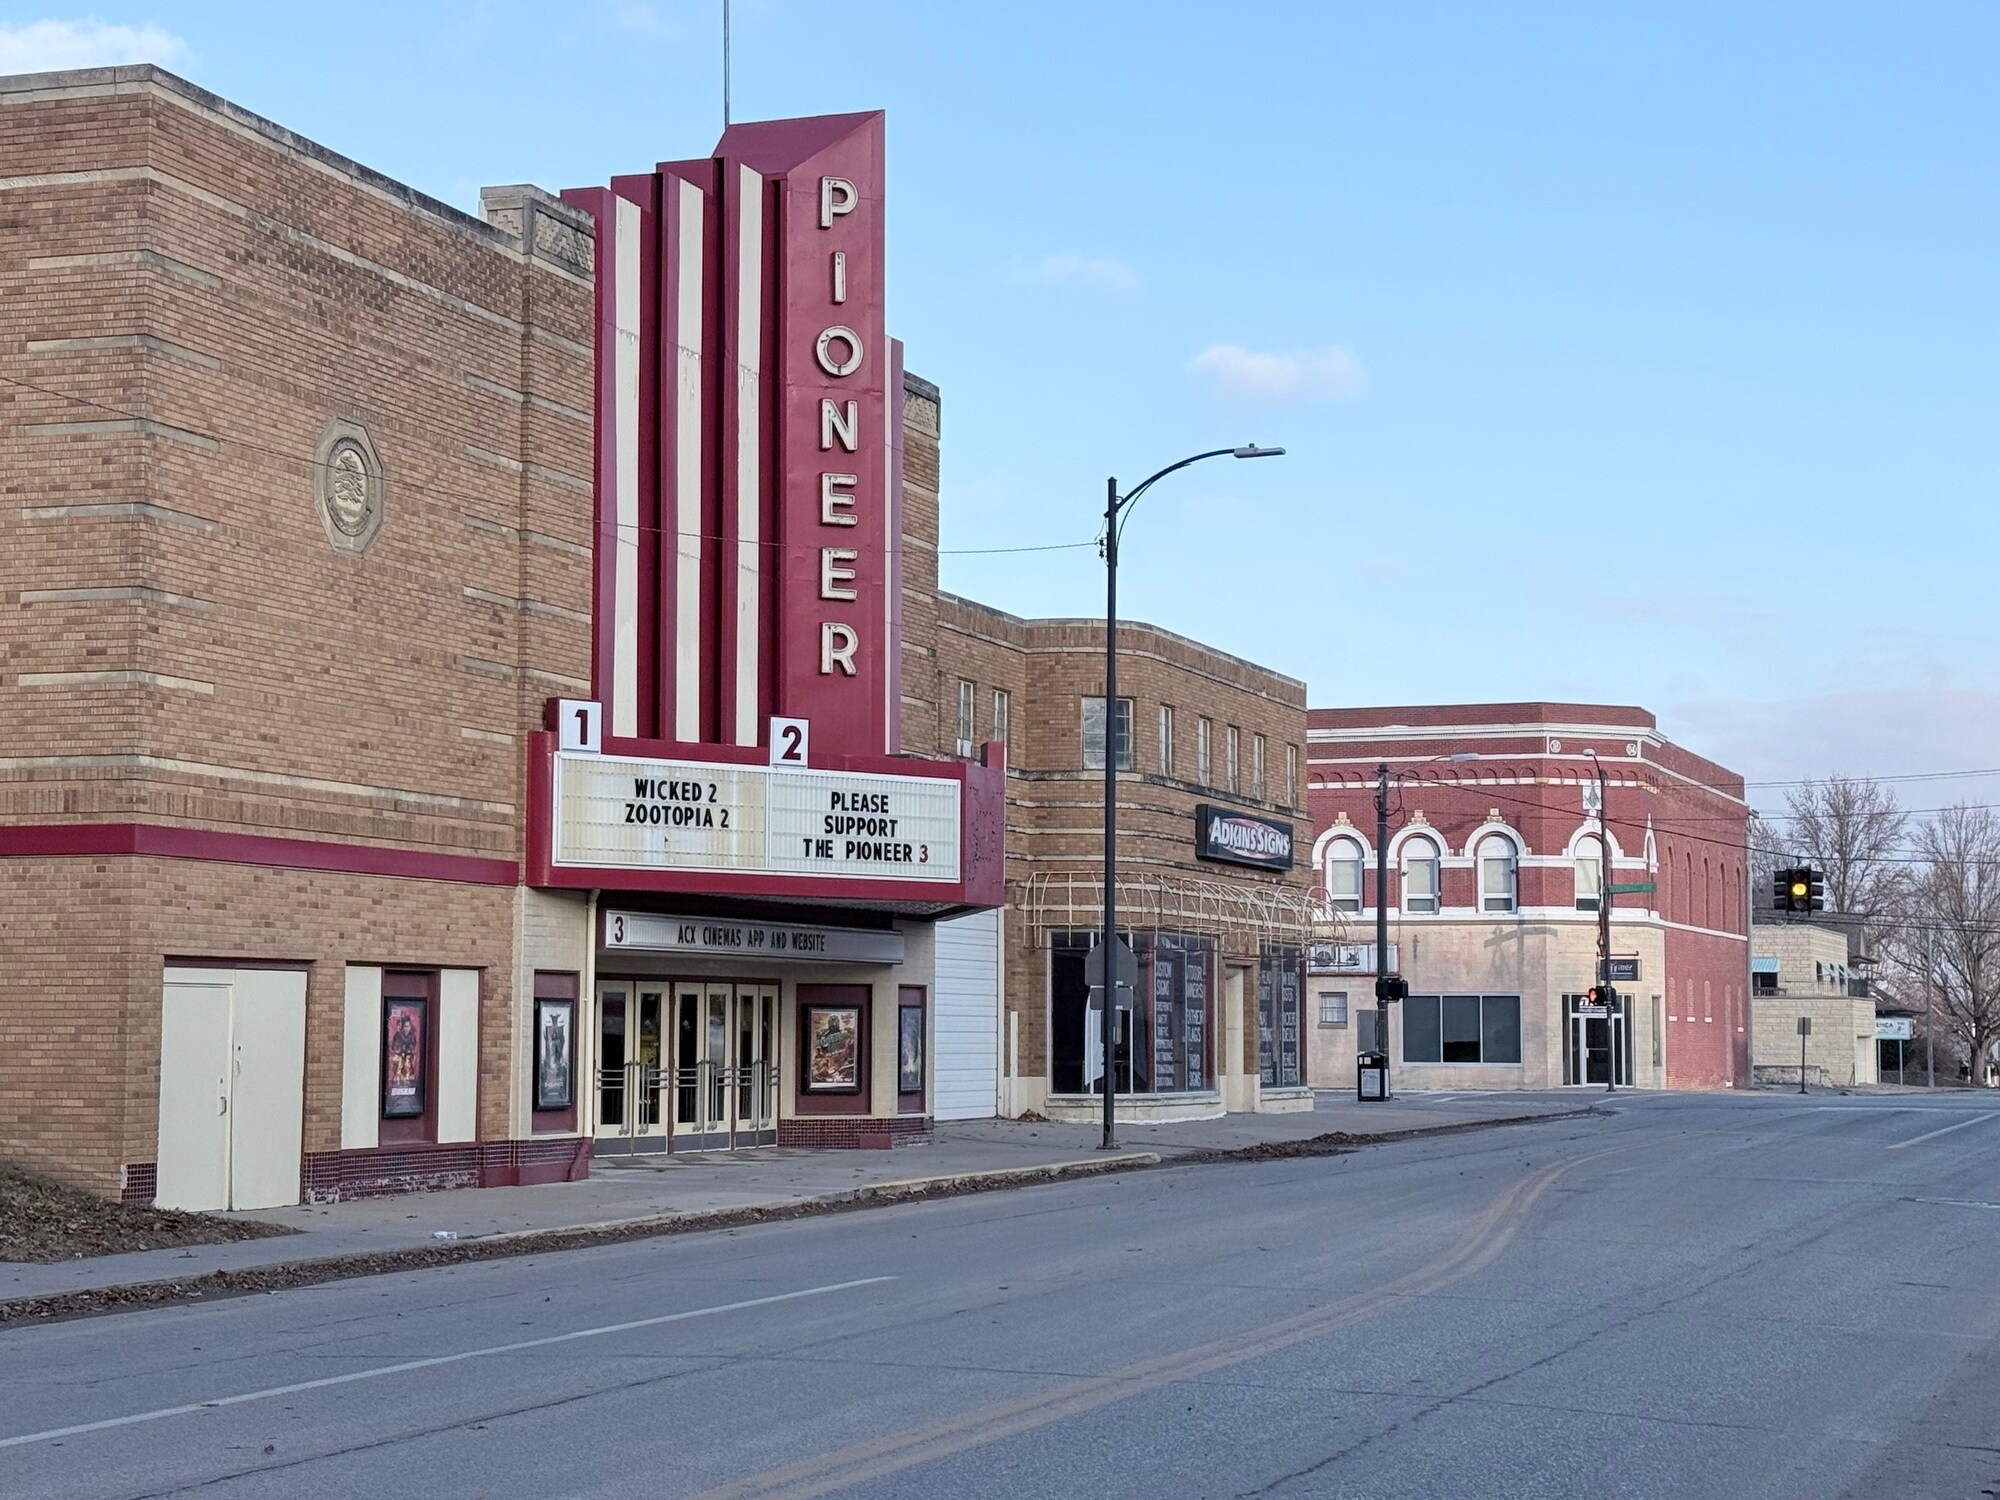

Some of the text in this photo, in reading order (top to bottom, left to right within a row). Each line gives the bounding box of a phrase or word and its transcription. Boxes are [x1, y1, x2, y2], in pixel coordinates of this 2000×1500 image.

[816, 175, 864, 677] PIONEER
[574, 709, 588, 745] 1
[782, 725, 802, 761] 2
[635, 779, 717, 803] WICKED 2
[831, 791, 889, 813] PLEASE
[625, 803, 729, 828] ZOOTOPIA 2
[824, 815, 898, 838] SUPPORT
[803, 838, 928, 863] THE PIONEER 3
[615, 916, 624, 943] 3
[677, 924, 826, 951] ACX CINEMAS APP AND WEBSITE
